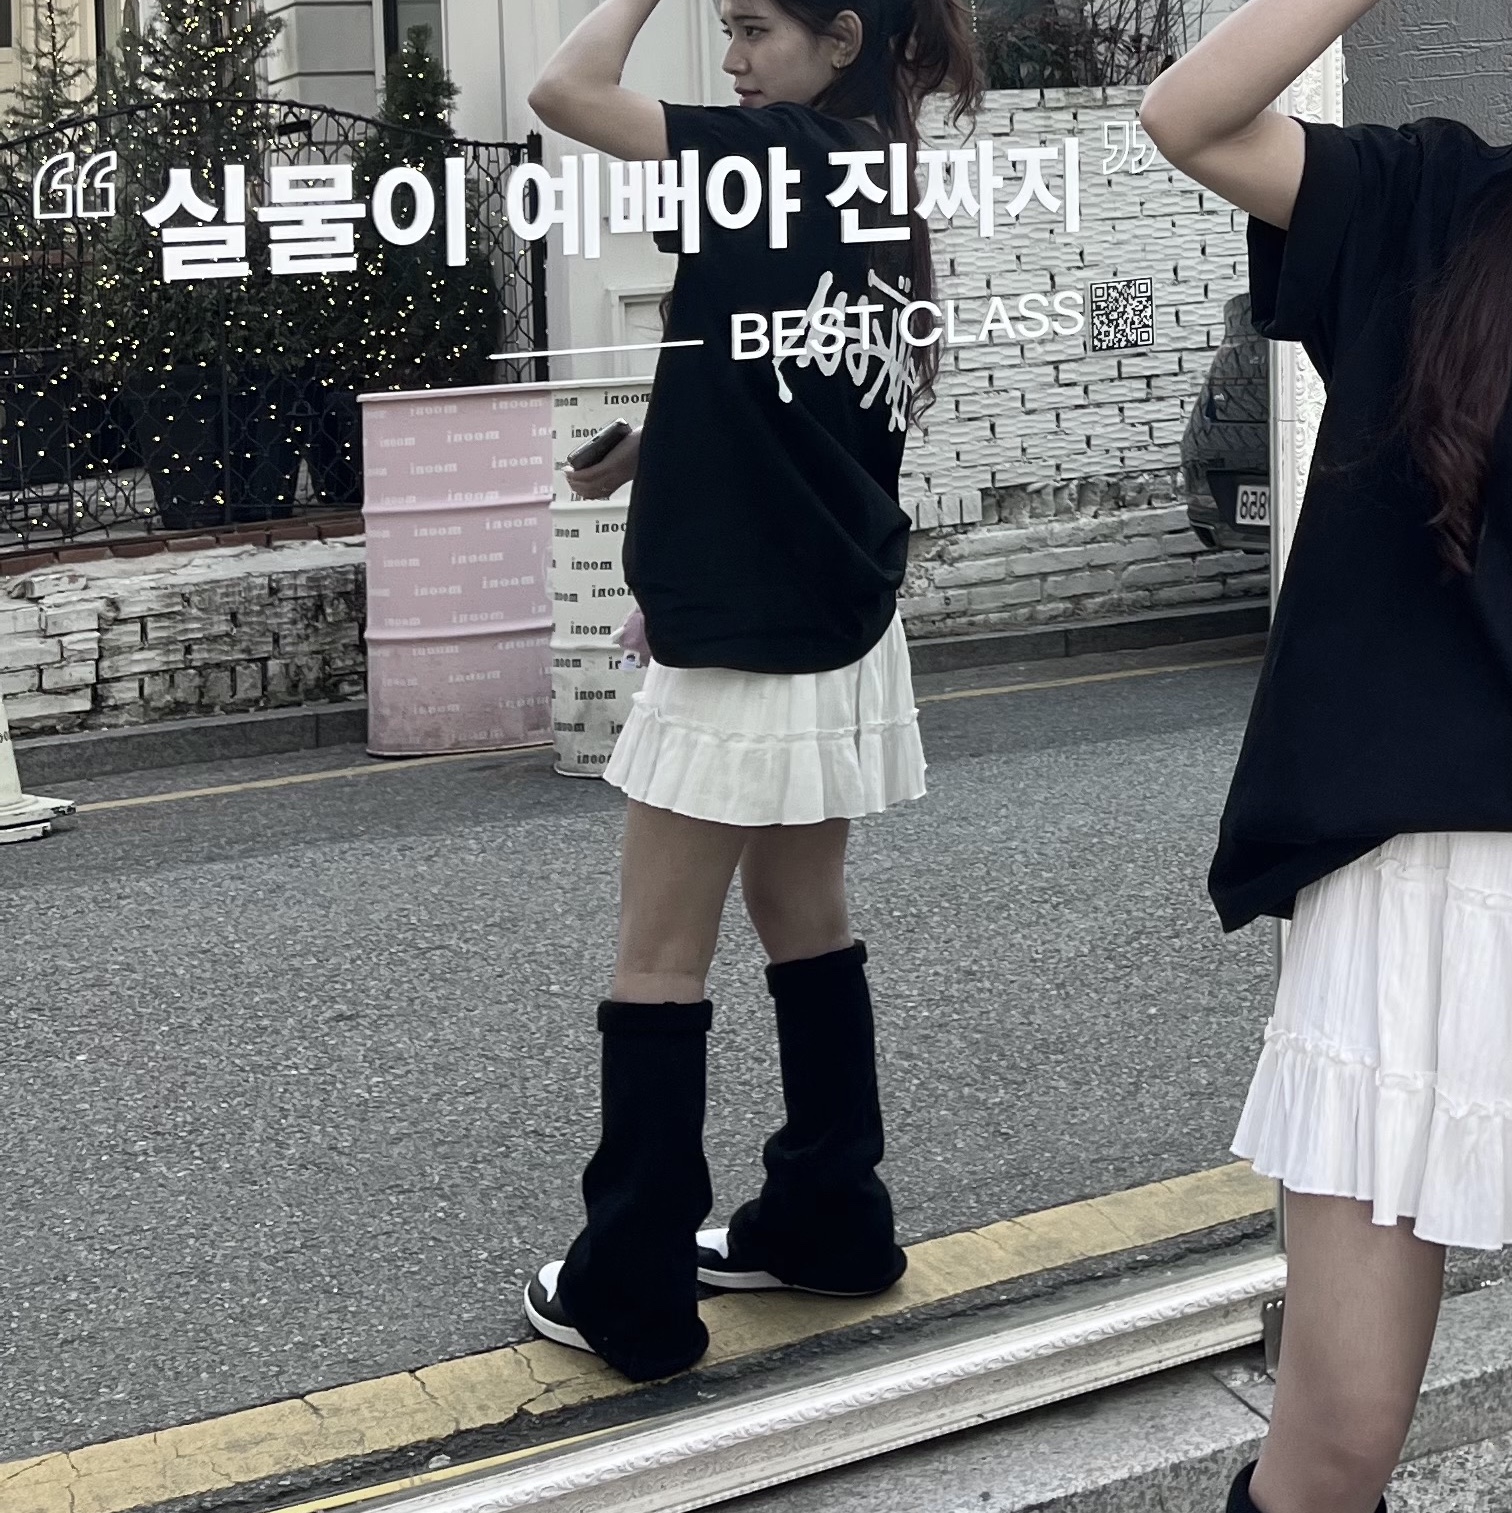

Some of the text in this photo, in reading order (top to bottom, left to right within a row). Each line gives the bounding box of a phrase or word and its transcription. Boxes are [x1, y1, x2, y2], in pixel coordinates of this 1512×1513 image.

[142, 137, 1081, 283] 실물이 예뻐야 진짜지
[731, 289, 1085, 361] BEST CLASS
